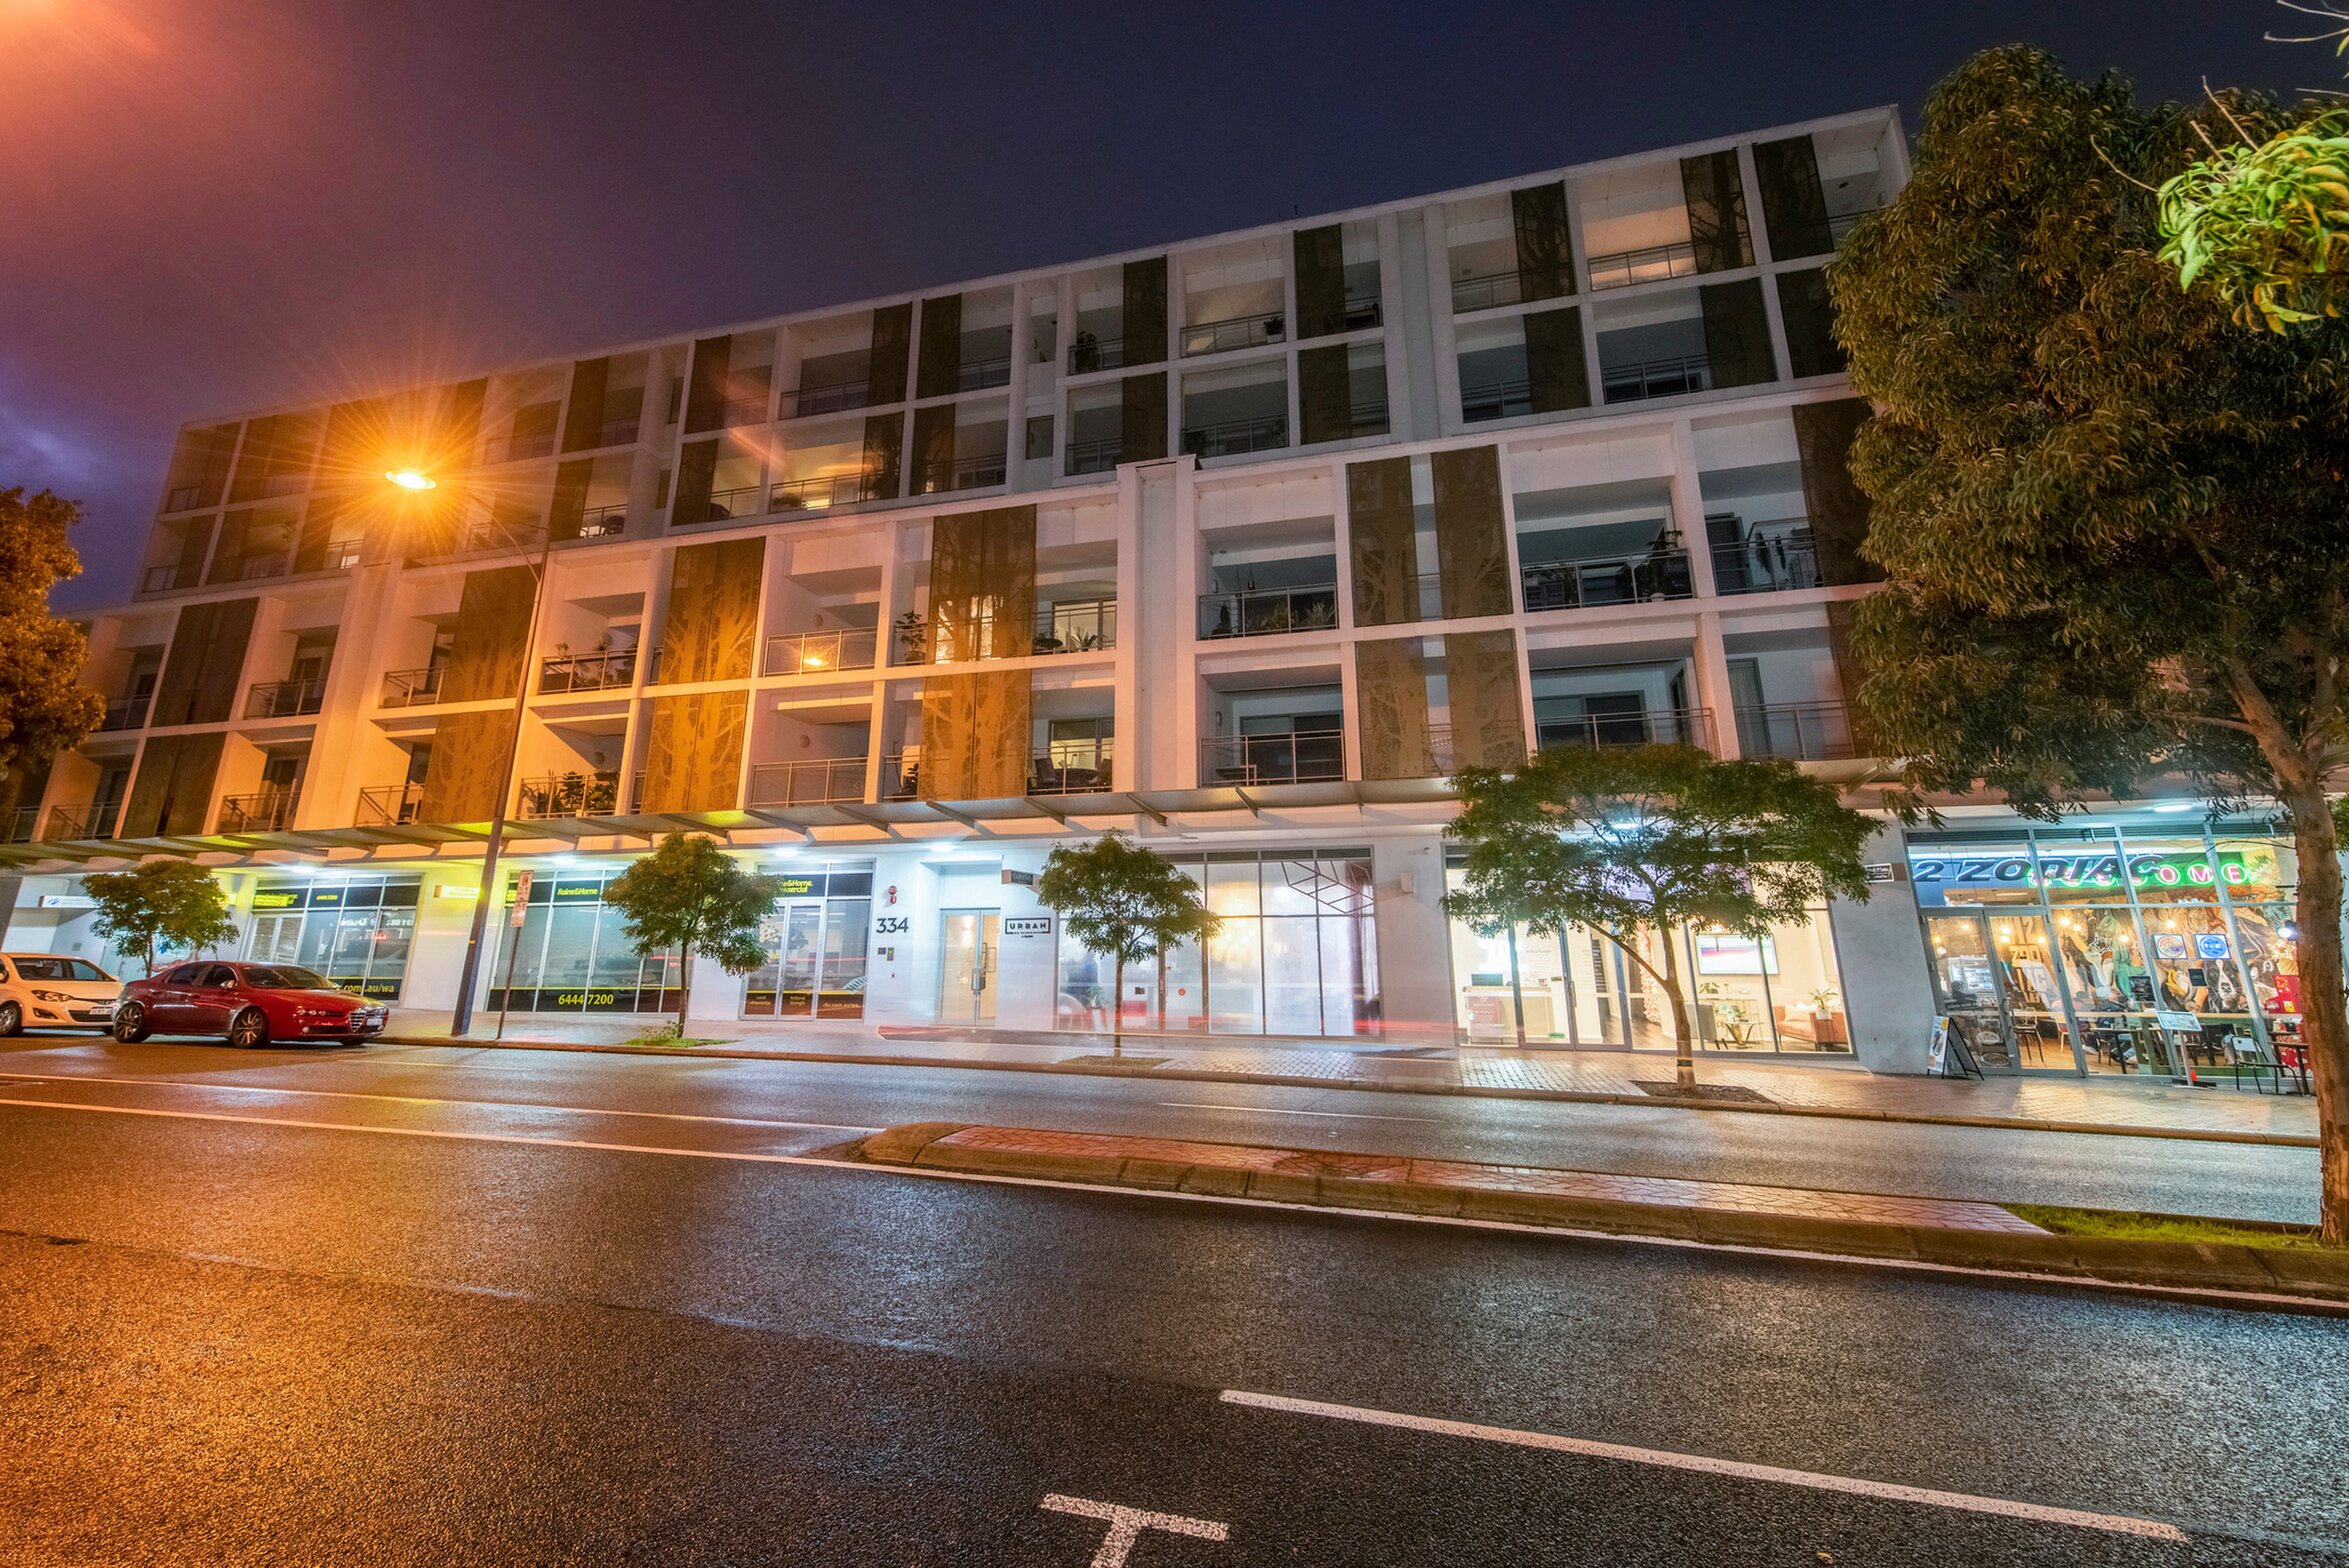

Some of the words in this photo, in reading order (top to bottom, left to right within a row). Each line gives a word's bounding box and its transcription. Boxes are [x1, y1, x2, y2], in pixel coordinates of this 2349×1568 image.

[1955, 854, 2165, 882] ZODIAC
[876, 917, 909, 934] 334
[1009, 922, 1047, 930] URBAN
[558, 993, 584, 1005] 6444
[587, 993, 614, 1005] 7200
